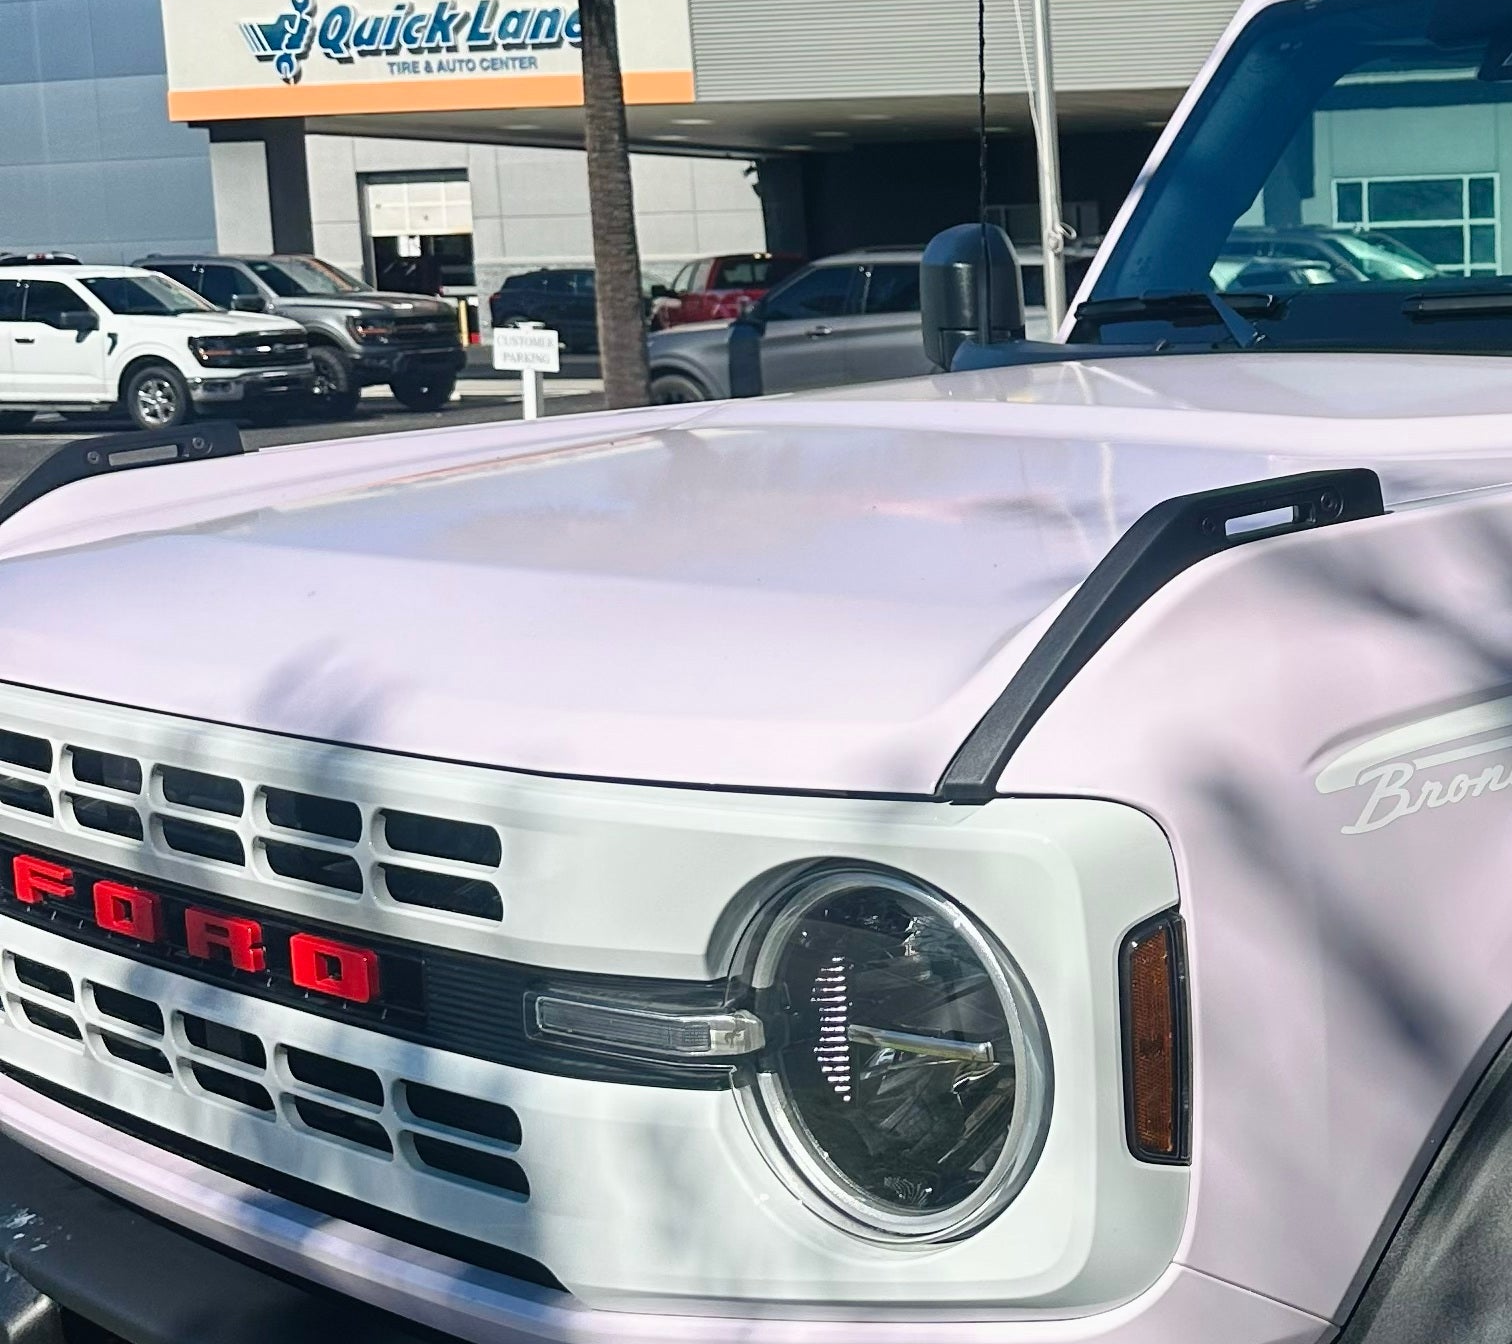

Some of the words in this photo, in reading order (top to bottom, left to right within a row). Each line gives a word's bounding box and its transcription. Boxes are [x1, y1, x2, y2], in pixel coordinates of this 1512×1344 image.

[318, 1, 459, 58] Quick
[387, 61, 421, 75] TIRE
[425, 60, 433, 74] &
[437, 59, 476, 74] AUTO
[481, 57, 538, 72] CENTER
[497, 335, 553, 348] CUSTOMER
[503, 351, 550, 363] PARKING
[13, 854, 381, 1004] FORD
